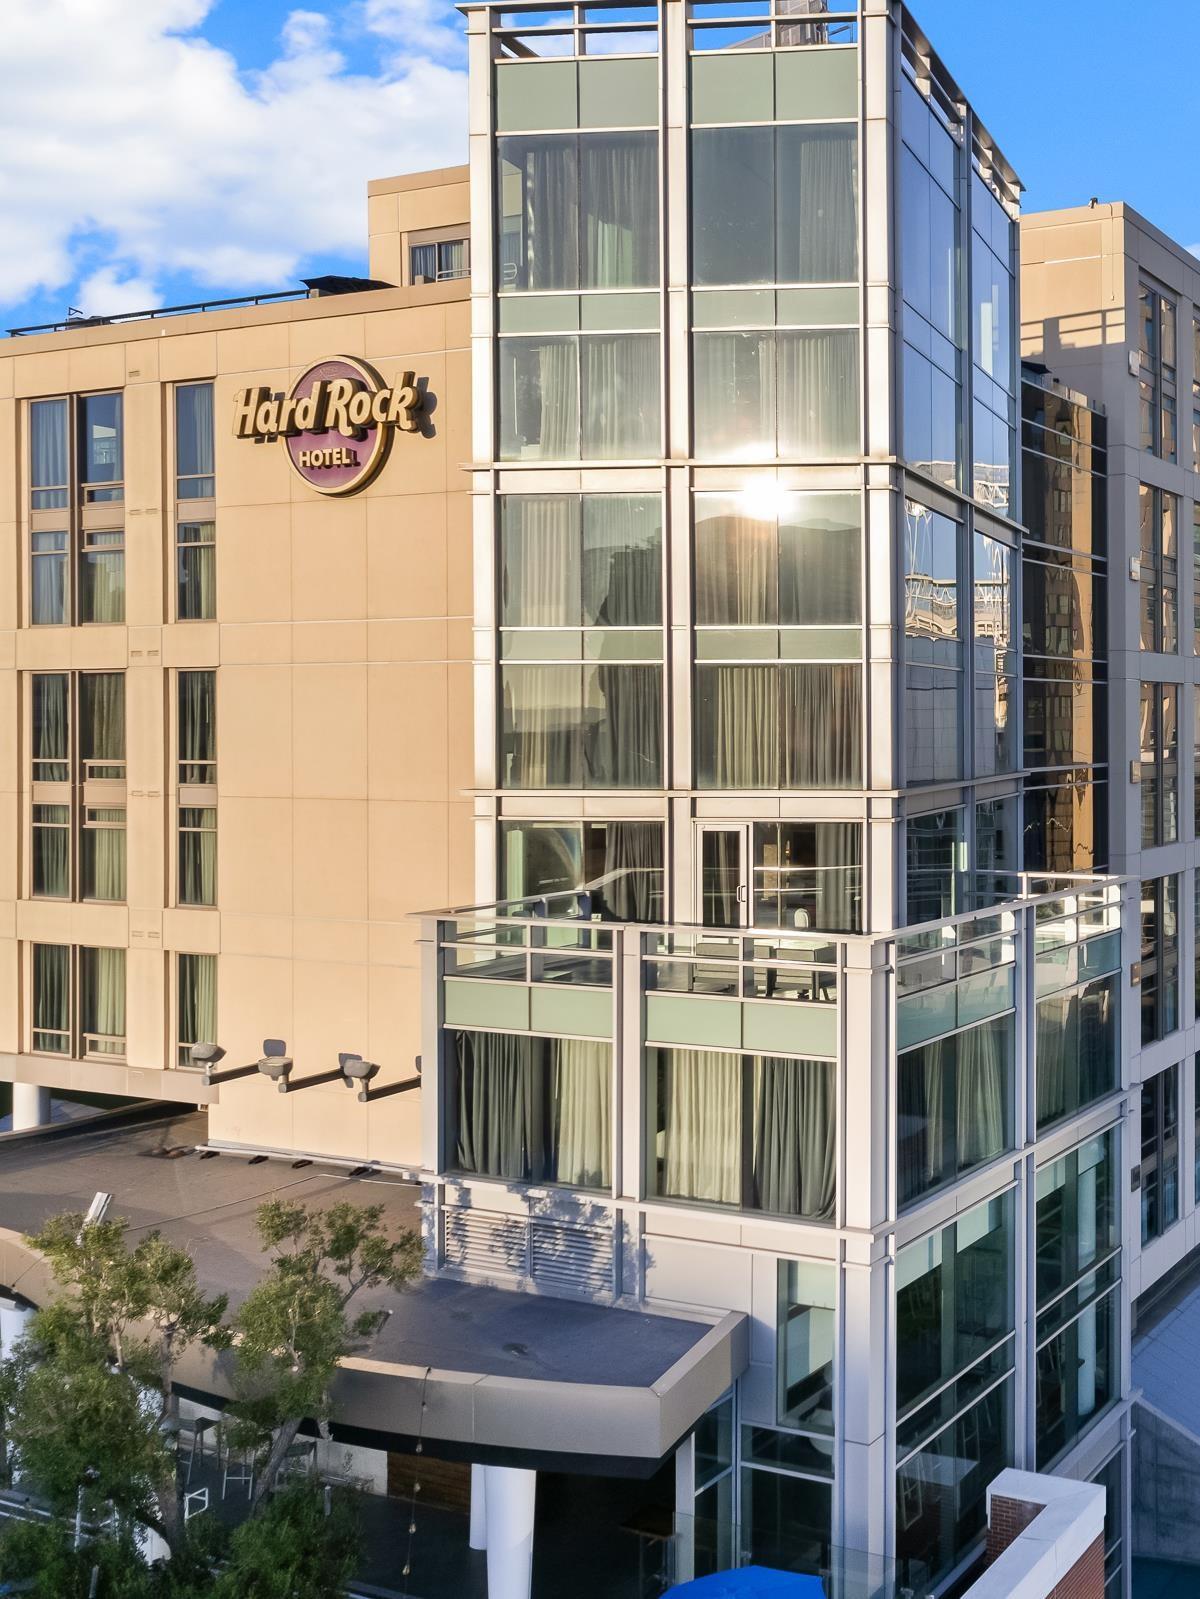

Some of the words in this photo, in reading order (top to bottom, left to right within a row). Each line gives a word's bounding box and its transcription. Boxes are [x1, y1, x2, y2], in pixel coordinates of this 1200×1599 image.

[232, 381, 324, 437] Hard
[326, 371, 421, 438] Rock
[299, 448, 353, 468] HOTEL
